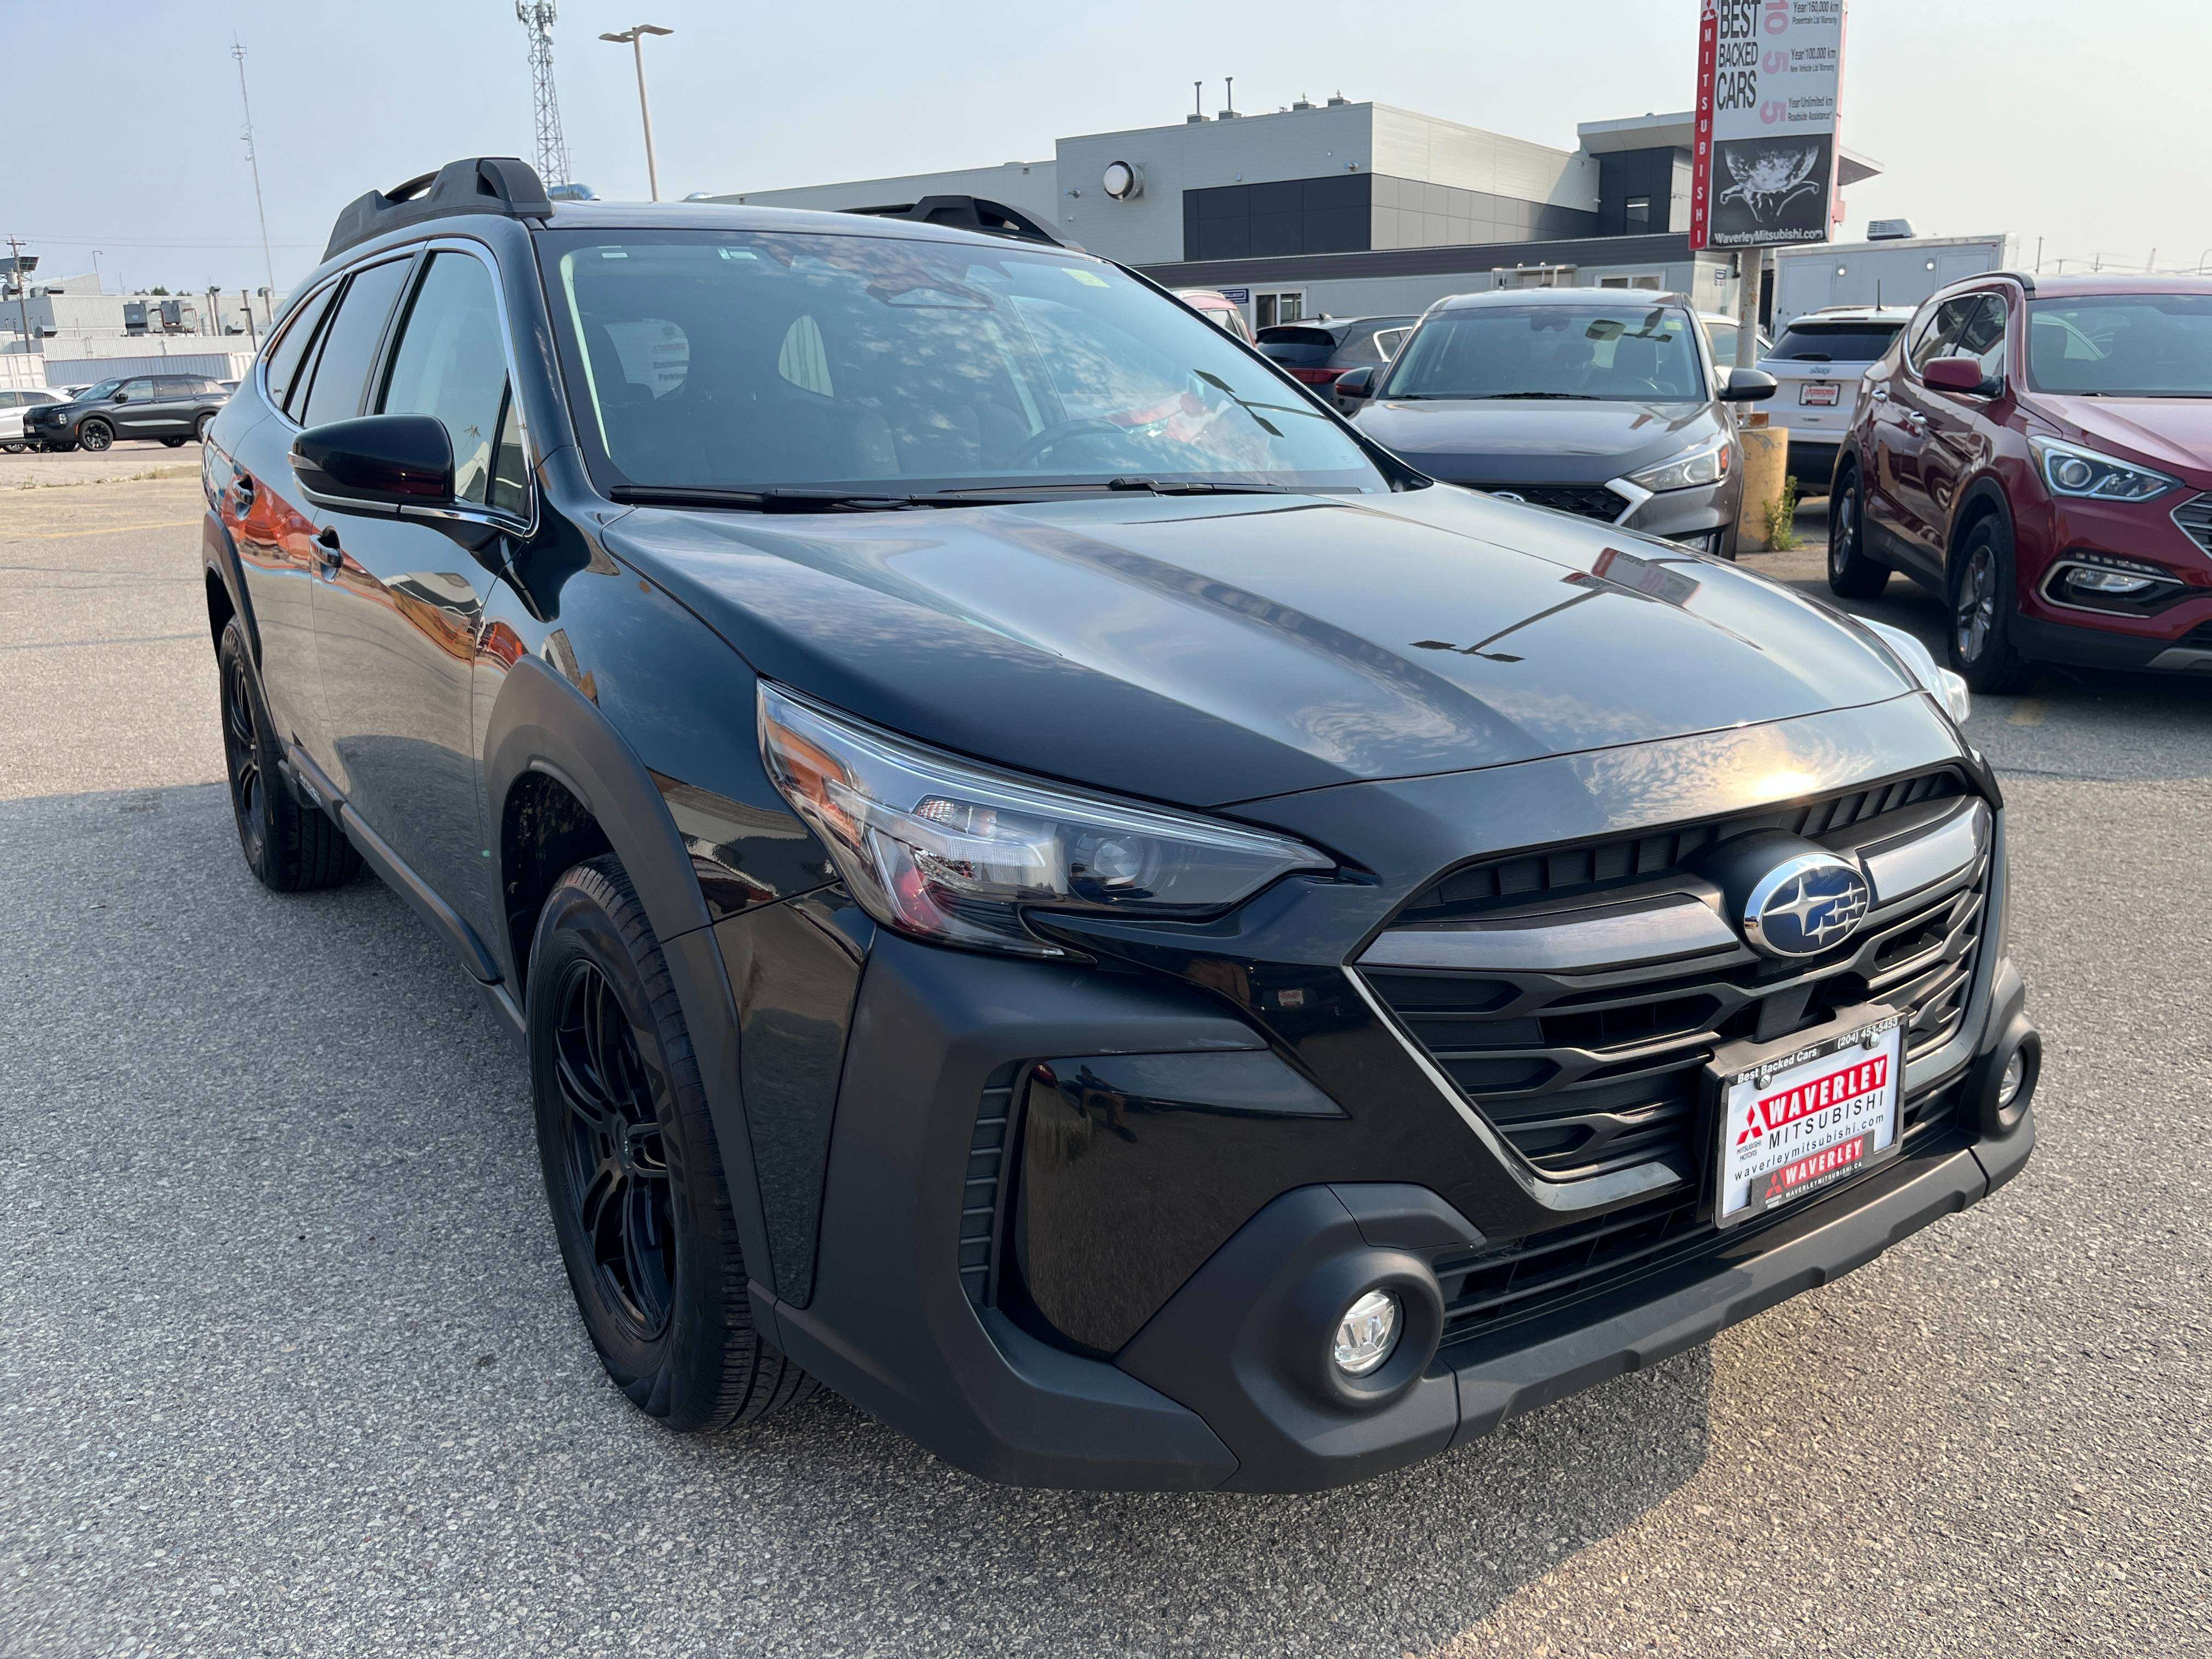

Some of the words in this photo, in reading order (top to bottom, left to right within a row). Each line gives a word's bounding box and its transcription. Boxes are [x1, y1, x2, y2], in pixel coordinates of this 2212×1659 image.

[1719, 0, 1760, 39] BEST
[1718, 42, 1758, 67] BACKED
[1762, 50, 1789, 75] 5
[1717, 70, 1757, 110] CARS
[1788, 97, 1801, 108] Year
[1801, 96, 1825, 108] Unlimited
[1759, 100, 1787, 125] 5
[1696, 28, 1712, 243] MITSUBISHI
[1714, 228, 1822, 245] WaverleyMitsubishi.com
[1737, 1067, 1759, 1084] Best
[1760, 1053, 1795, 1076] Backed
[1796, 1047, 1818, 1063] Cars
[1837, 1032, 1859, 1050] (204)
[1860, 1017, 1898, 1039] 453-5453
[1768, 1059, 1884, 1125] WAVERLEY
[1769, 1090, 1883, 1150] MITSUBISHI
[1734, 1113, 1883, 1181] waverleymitsubishi.com
[1785, 1138, 1862, 1185] WAVERLEY
[1785, 1161, 1863, 1198] WAVERLEYMITSUBISHI.CA
